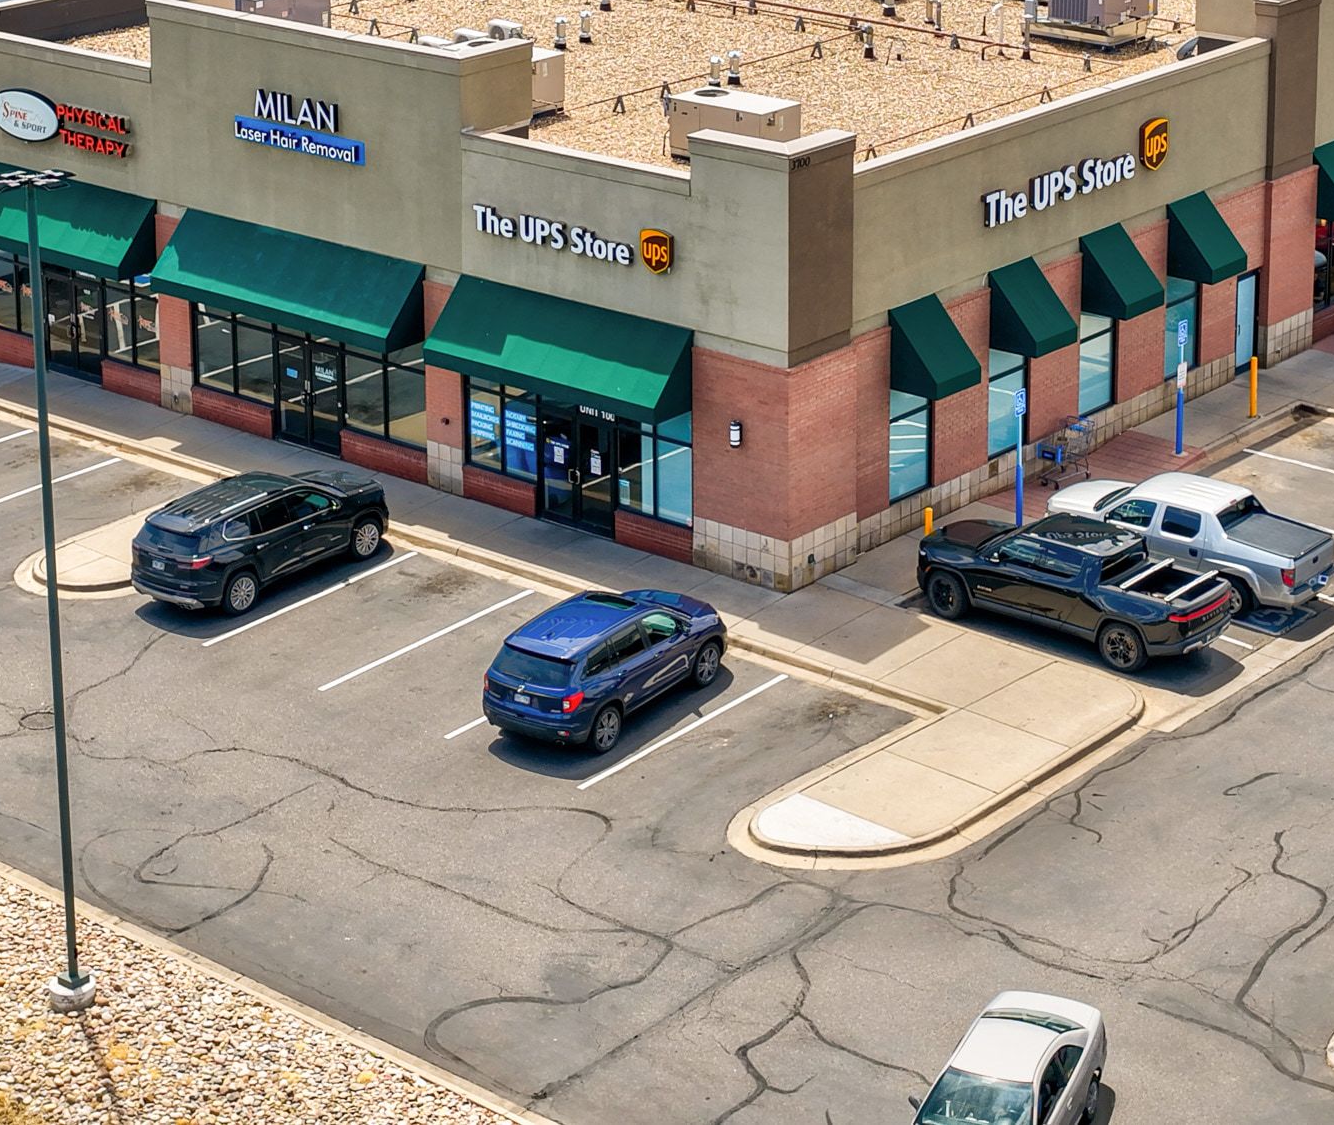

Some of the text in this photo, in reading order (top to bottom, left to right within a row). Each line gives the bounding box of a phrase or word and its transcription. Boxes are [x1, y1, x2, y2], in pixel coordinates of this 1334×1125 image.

[3, 101, 27, 121] SPINE
[56, 104, 126, 135] PHYSICAL
[255, 89, 338, 133] MILAN
[21, 121, 47, 134] SPORT
[234, 121, 356, 163] Laser Hair Removal
[59, 129, 125, 158] THERAPY
[1146, 133, 1168, 163] ups
[791, 157, 811, 171] 3700
[985, 152, 1137, 228] The UPS Store
[473, 204, 633, 266] The UPS Store
[643, 242, 668, 267] ups
